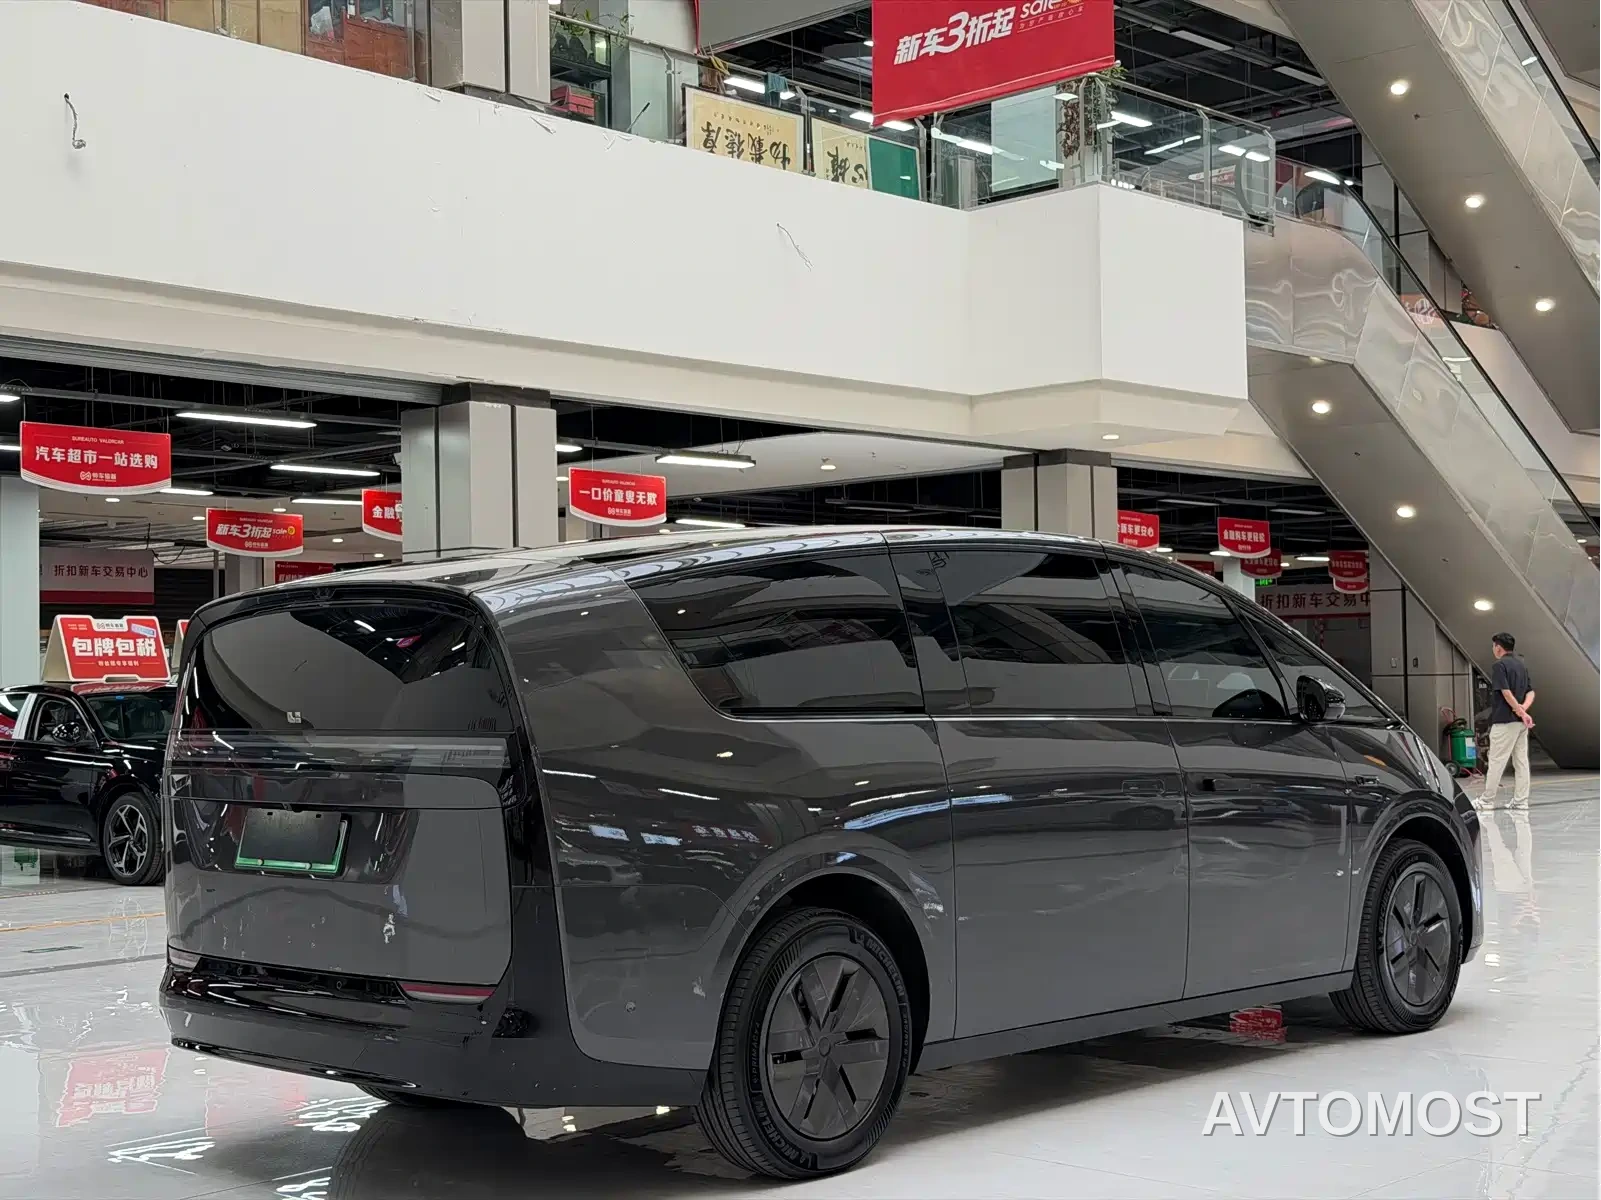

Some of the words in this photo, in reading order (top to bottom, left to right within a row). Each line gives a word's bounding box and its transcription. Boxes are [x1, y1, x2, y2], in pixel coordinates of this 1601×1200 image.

[893, 6, 1017, 66] 新车3折起
[35, 445, 158, 470] 汽车超市一站选购
[579, 487, 657, 506] 一口价童叟无欺
[371, 505, 402, 520] 金融
[215, 523, 273, 540] 新车3折起
[53, 564, 149, 579] 折扣新车交易中心
[72, 637, 157, 657] 包牌包税
[867, 937, 905, 997] MICHELIN
[755, 1098, 799, 1162] MICHELIN
